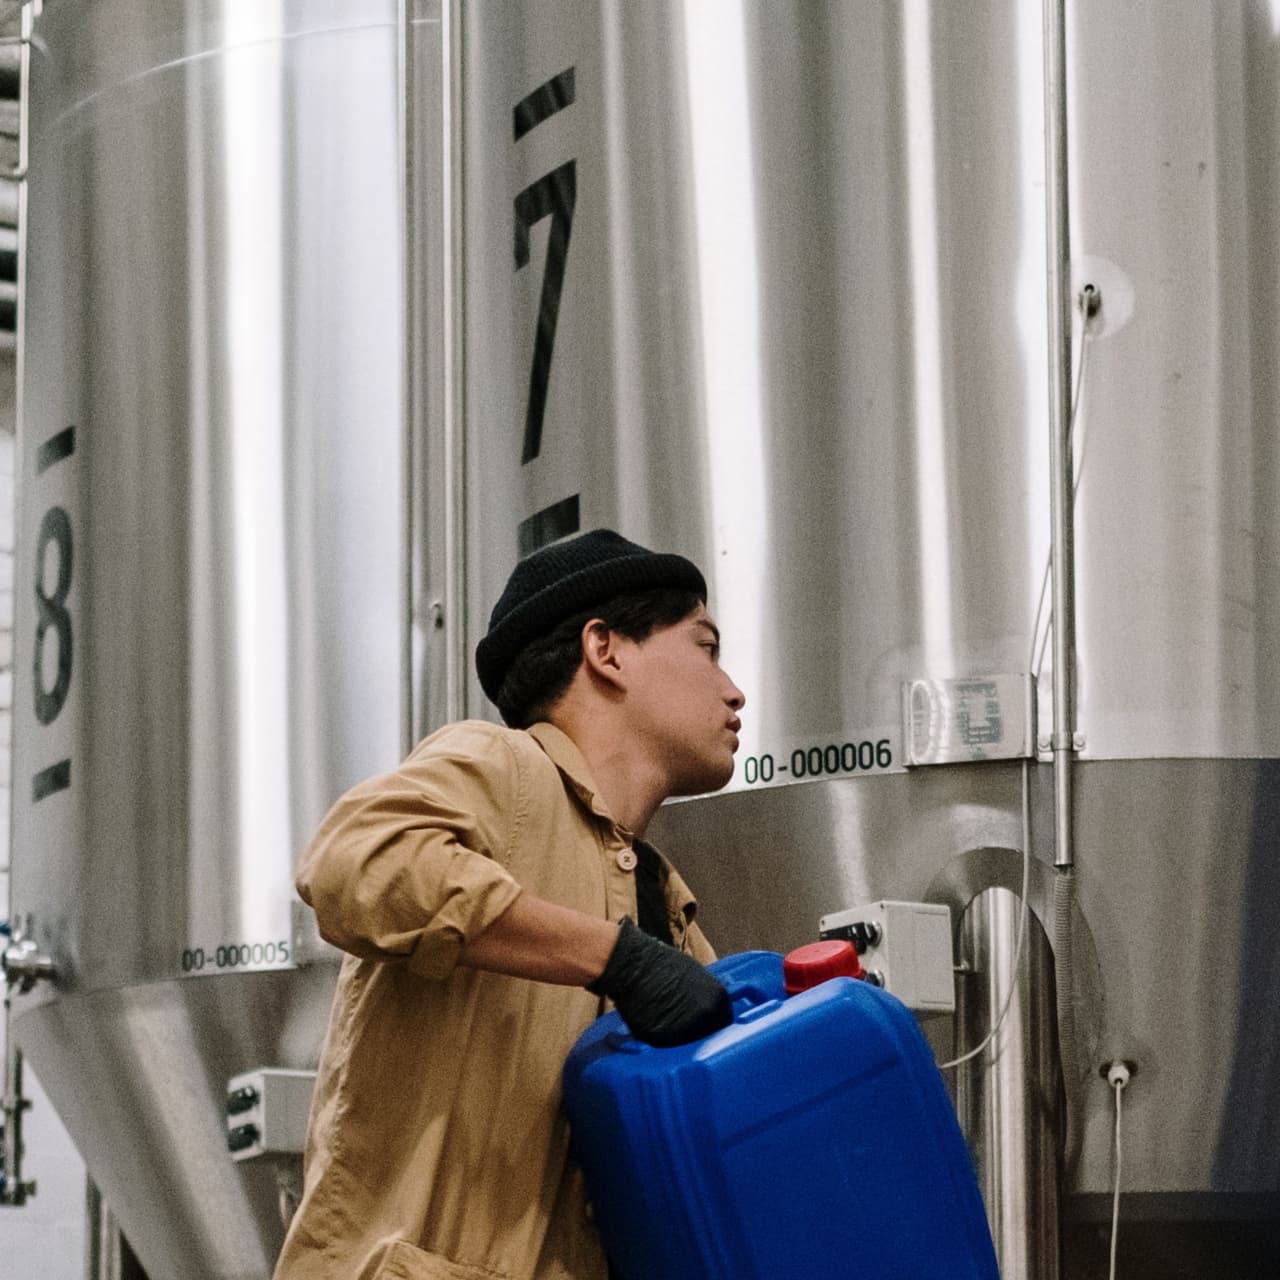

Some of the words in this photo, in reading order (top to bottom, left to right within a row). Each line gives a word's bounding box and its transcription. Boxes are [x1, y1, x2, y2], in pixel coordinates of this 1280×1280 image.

[513, 158, 577, 466] 7
[33, 506, 74, 726] 8
[744, 739, 892, 784] 00-000006
[182, 941, 289, 972] 00-000005
